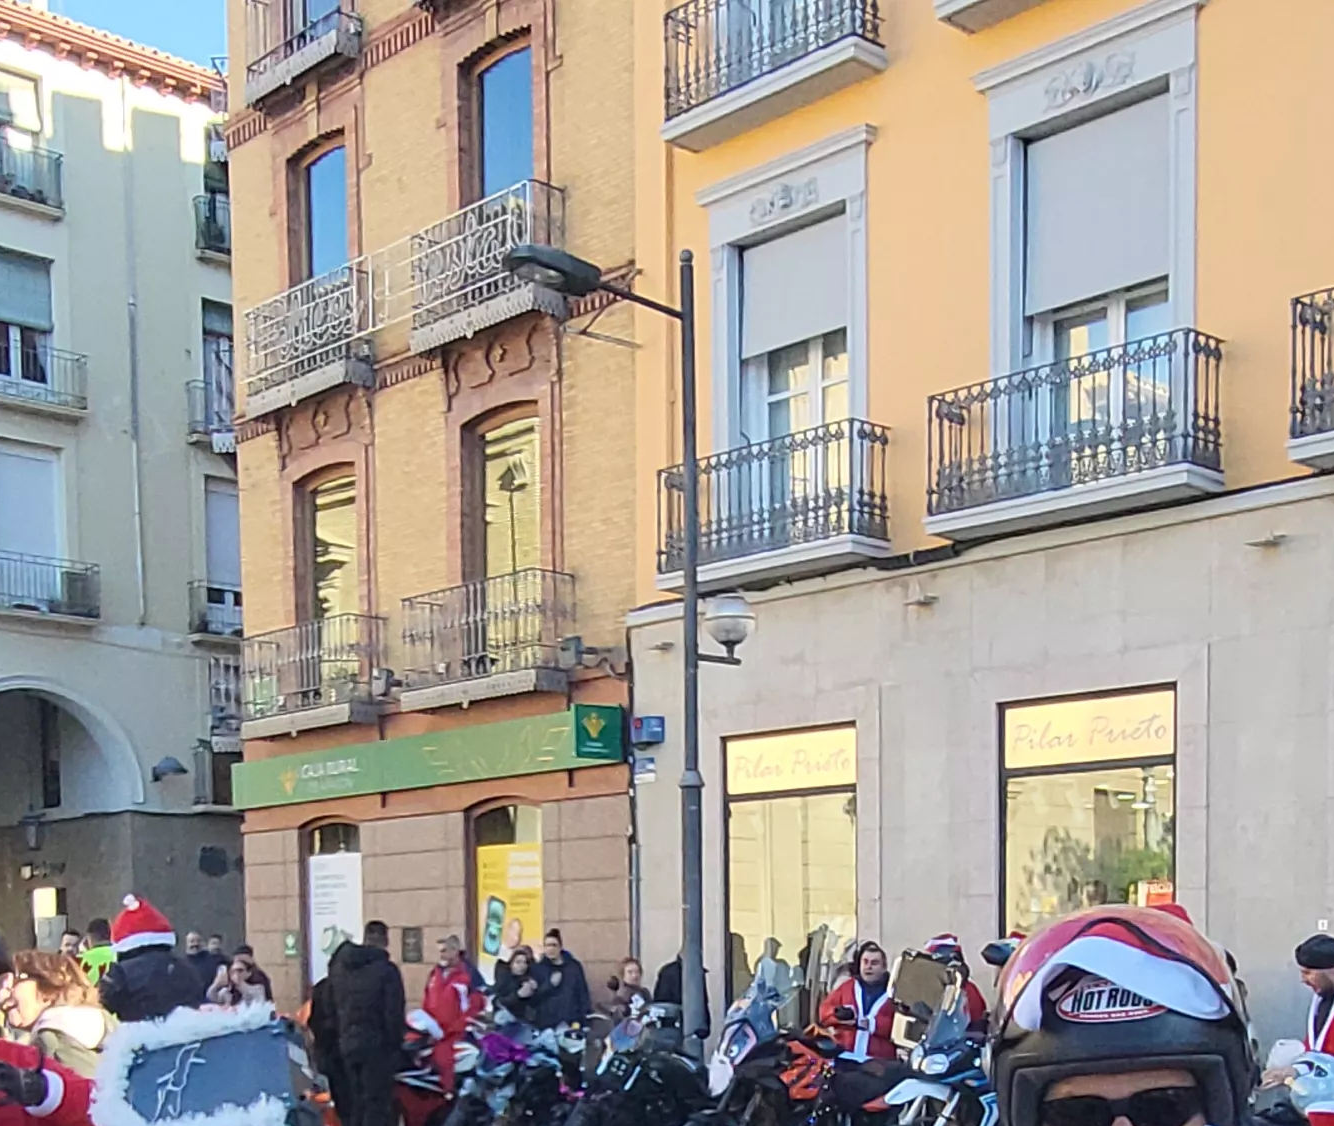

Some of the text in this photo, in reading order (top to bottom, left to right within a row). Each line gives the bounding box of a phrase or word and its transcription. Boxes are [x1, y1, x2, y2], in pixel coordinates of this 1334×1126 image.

[1012, 712, 1167, 752] Pilar Prieto
[733, 748, 851, 782] Pilar Prieto
[1071, 987, 1106, 1013] HOT
